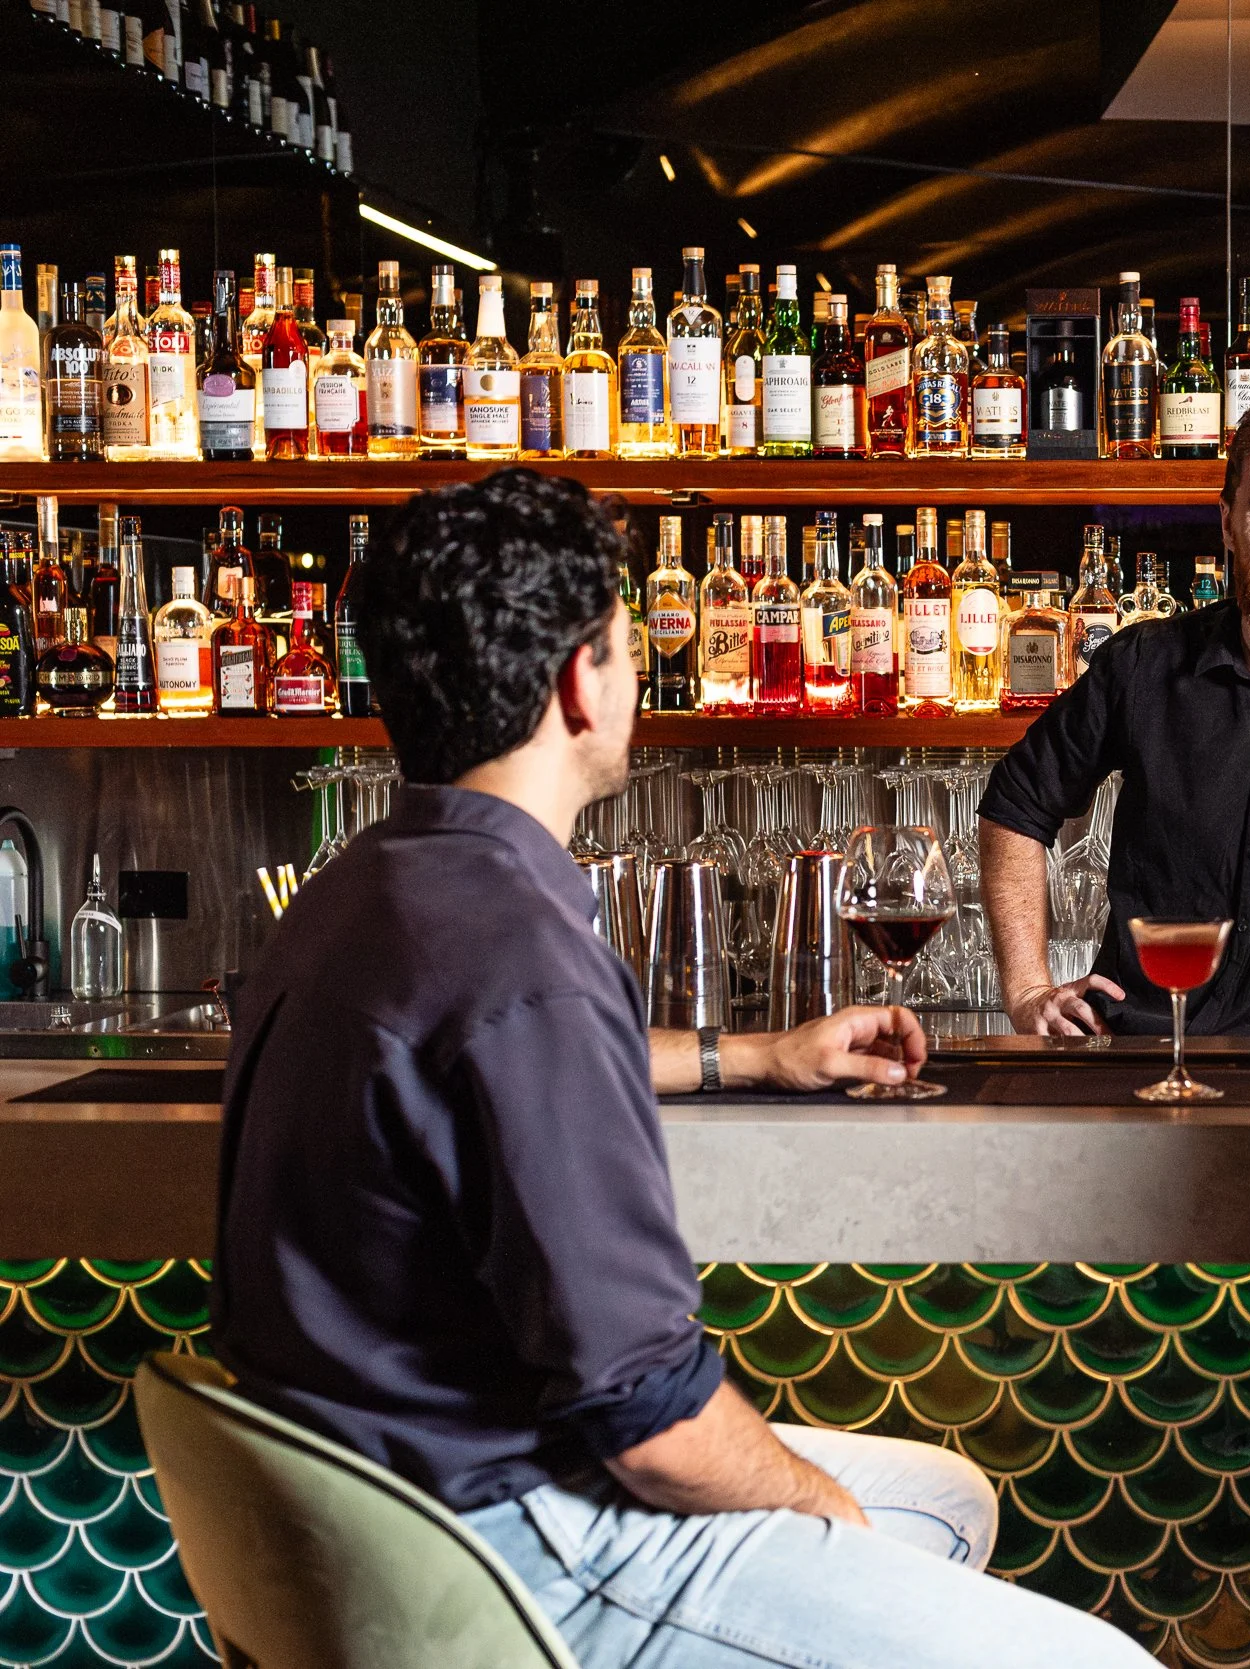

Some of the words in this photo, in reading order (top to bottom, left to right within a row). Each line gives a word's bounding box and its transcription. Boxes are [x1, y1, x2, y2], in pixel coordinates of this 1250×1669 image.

[243, 339, 262, 351] STO
[51, 348, 101, 361] ABSOLUT
[66, 360, 88, 374] 100
[868, 366, 886, 376] GOLD
[887, 359, 906, 371] LABEL
[687, 376, 697, 385] 12
[764, 377, 808, 386] APHROAIG
[1109, 387, 1149, 398] WATERS
[930, 395, 942, 405] 18
[1166, 407, 1210, 415] REDBREAST
[741, 422, 748, 430] 8
[1183, 424, 1193, 432] 12
[756, 610, 799, 624] CAMPAR
[650, 617, 692, 630] AVERNA
[829, 614, 851, 632] APE
[851, 619, 886, 628] ULASSANO
[117, 643, 146, 657] ALLIANO
[708, 631, 748, 660] Bitter
[1013, 655, 1053, 664] DISARONNO
[159, 681, 197, 689] AUTONOMY
